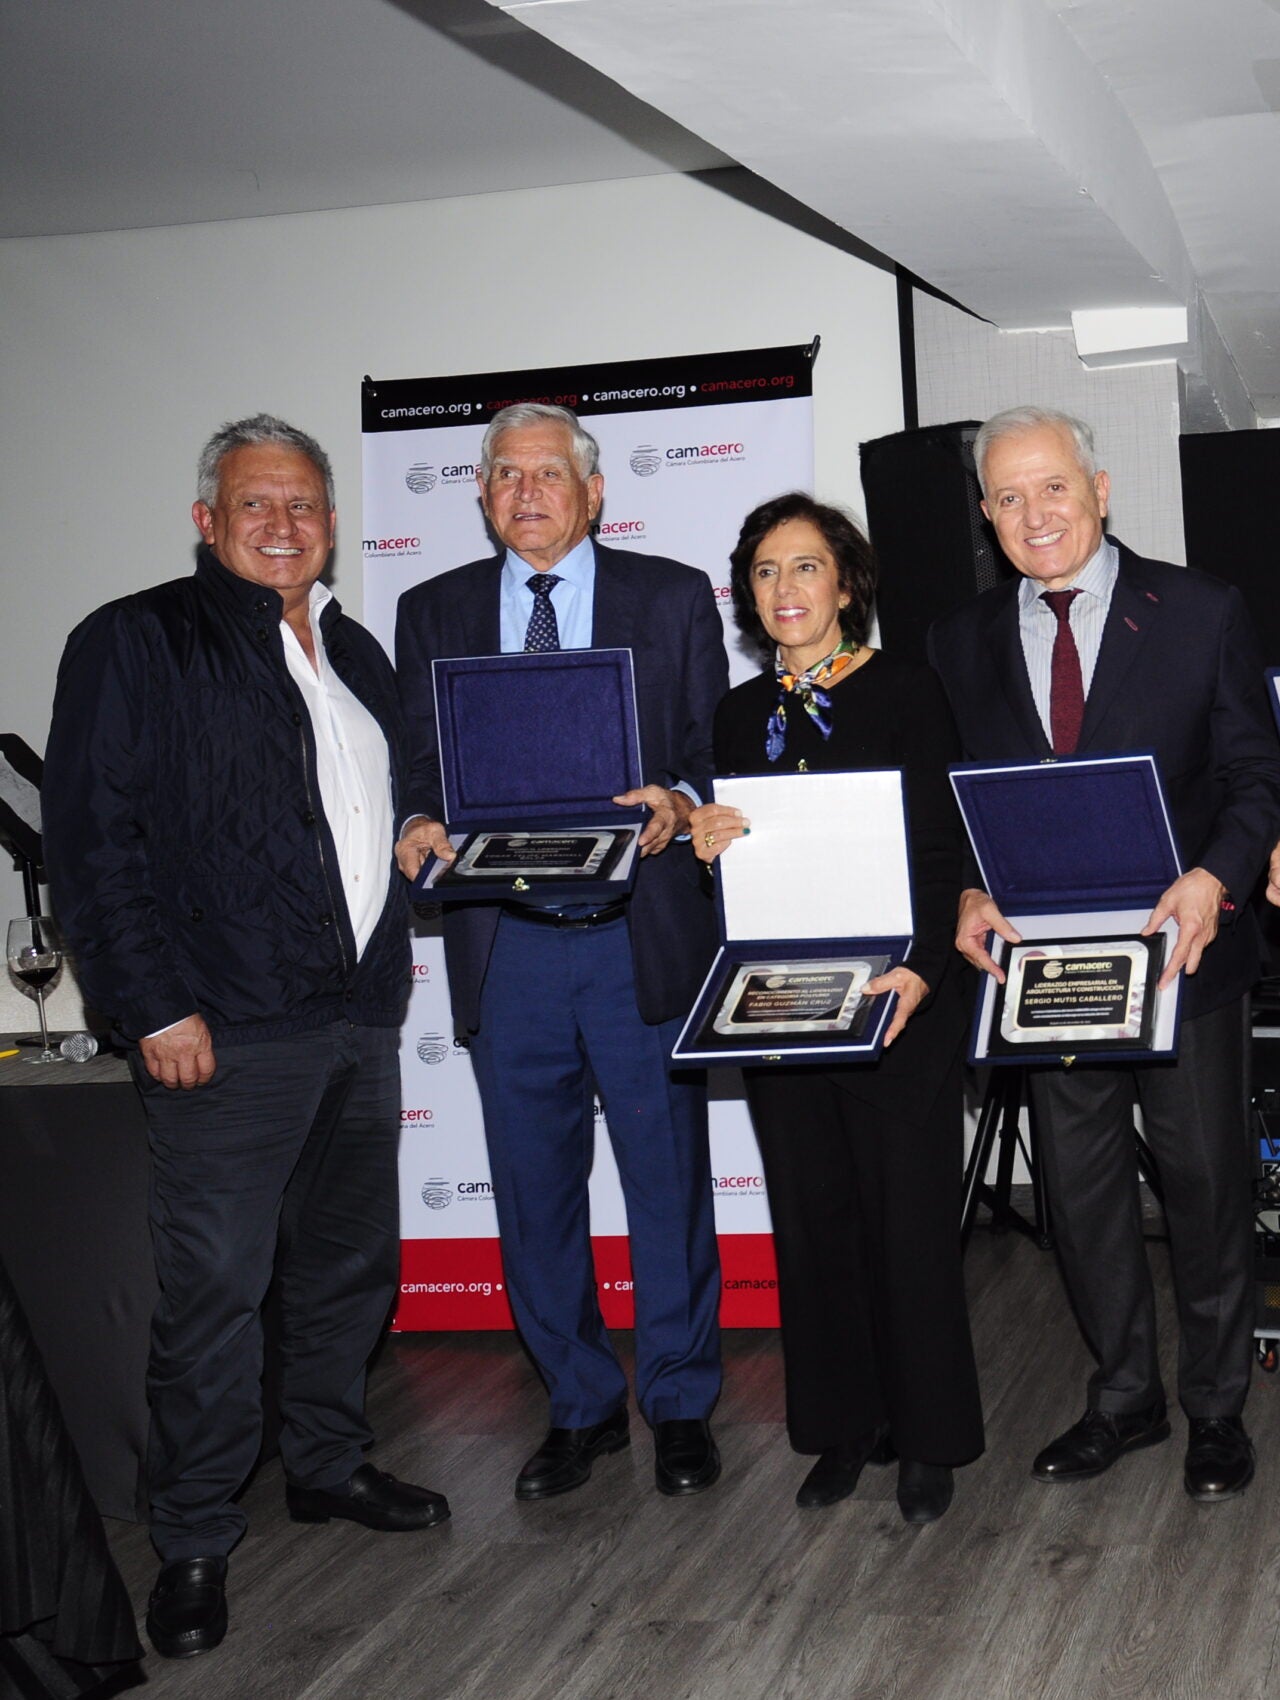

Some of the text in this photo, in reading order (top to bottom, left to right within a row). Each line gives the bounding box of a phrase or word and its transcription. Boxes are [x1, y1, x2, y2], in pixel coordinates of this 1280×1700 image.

[380, 402, 471, 419] camacero.org
[593, 384, 686, 402] camacero.org
[700, 375, 794, 392] camacero.org
[665, 442, 745, 459] camacero
[362, 537, 421, 551] macero
[1065, 962, 1112, 970] camacero
[1053, 996, 1077, 1004] MUTIS
[400, 1282, 492, 1296] camacero.org
